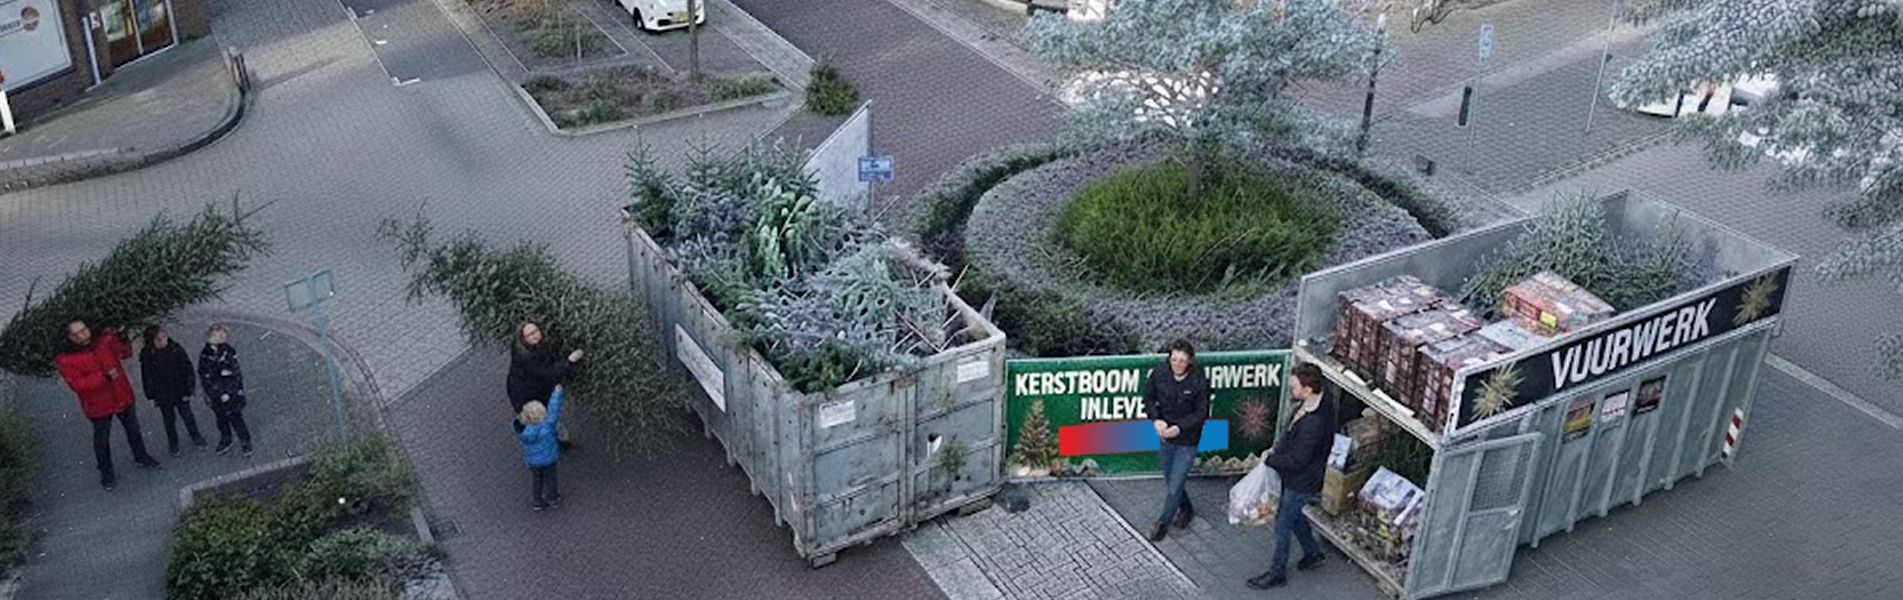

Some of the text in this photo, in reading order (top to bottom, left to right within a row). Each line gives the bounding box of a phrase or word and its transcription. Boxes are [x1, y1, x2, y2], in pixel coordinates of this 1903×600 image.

[1551, 298, 1717, 389] VUURWERK
[1015, 369, 1139, 395] KERSTBOOM
[1205, 364, 1281, 388] RWERK
[1081, 396, 1148, 420] INLEVE
